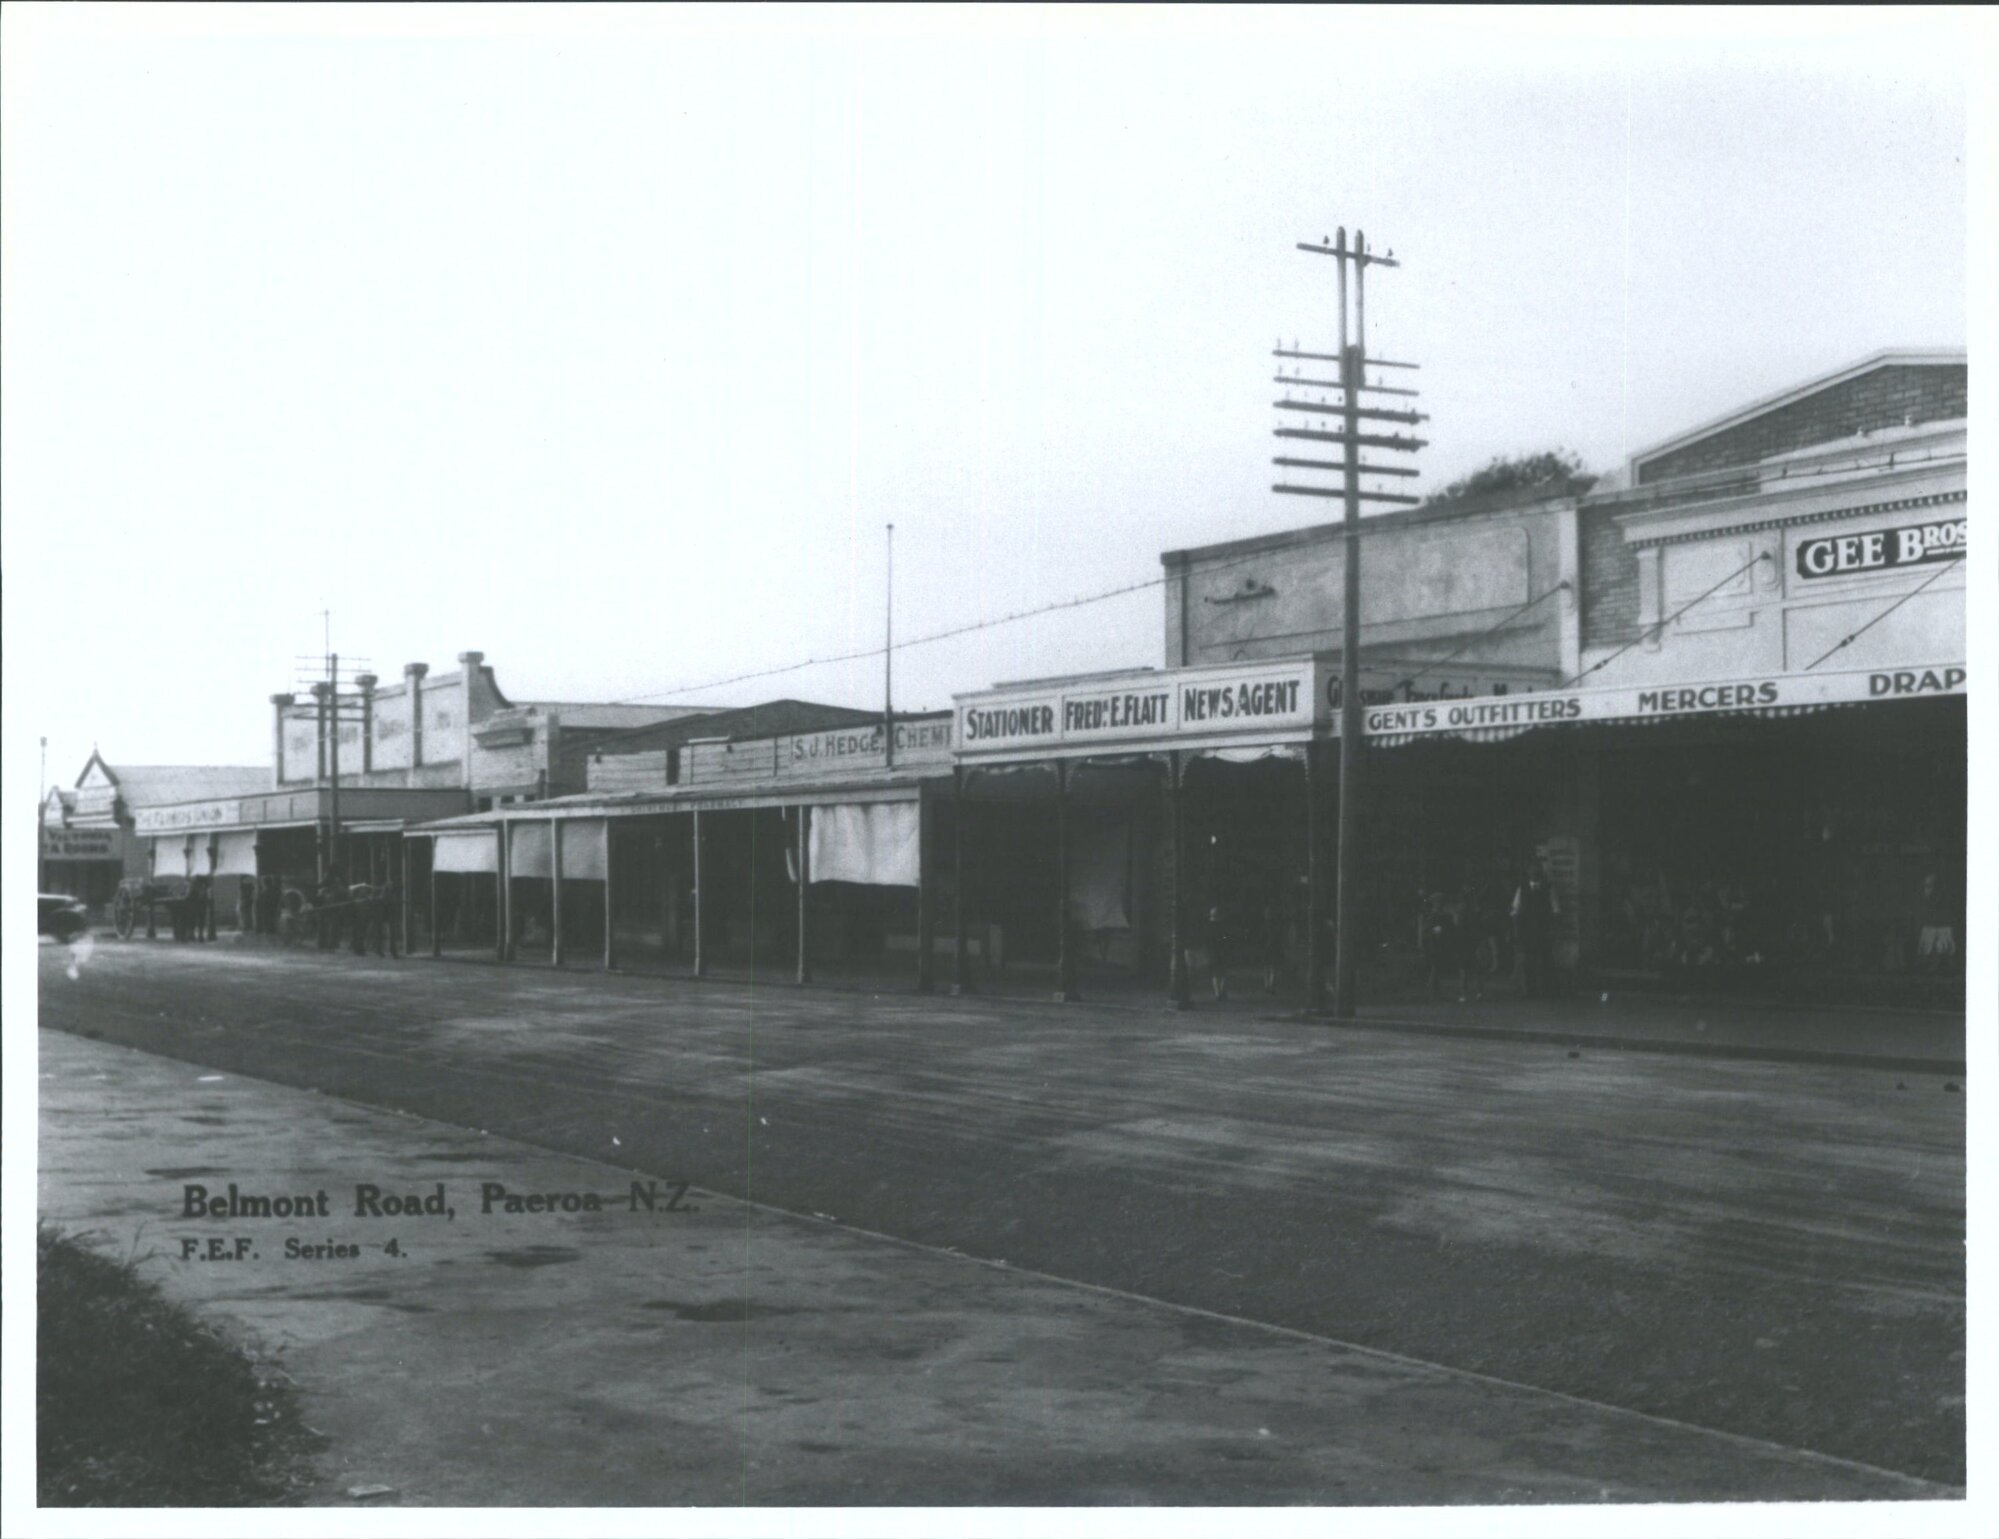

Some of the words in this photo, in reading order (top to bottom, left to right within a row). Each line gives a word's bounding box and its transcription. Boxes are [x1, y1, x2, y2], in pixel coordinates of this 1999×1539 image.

[1805, 533, 1885, 574] GEE
[1448, 698, 1581, 726] OUTFITTERS
[1638, 681, 1778, 712] MERCERS
[1868, 668, 1967, 697] DRAP
[966, 705, 1053, 740] STATIONER
